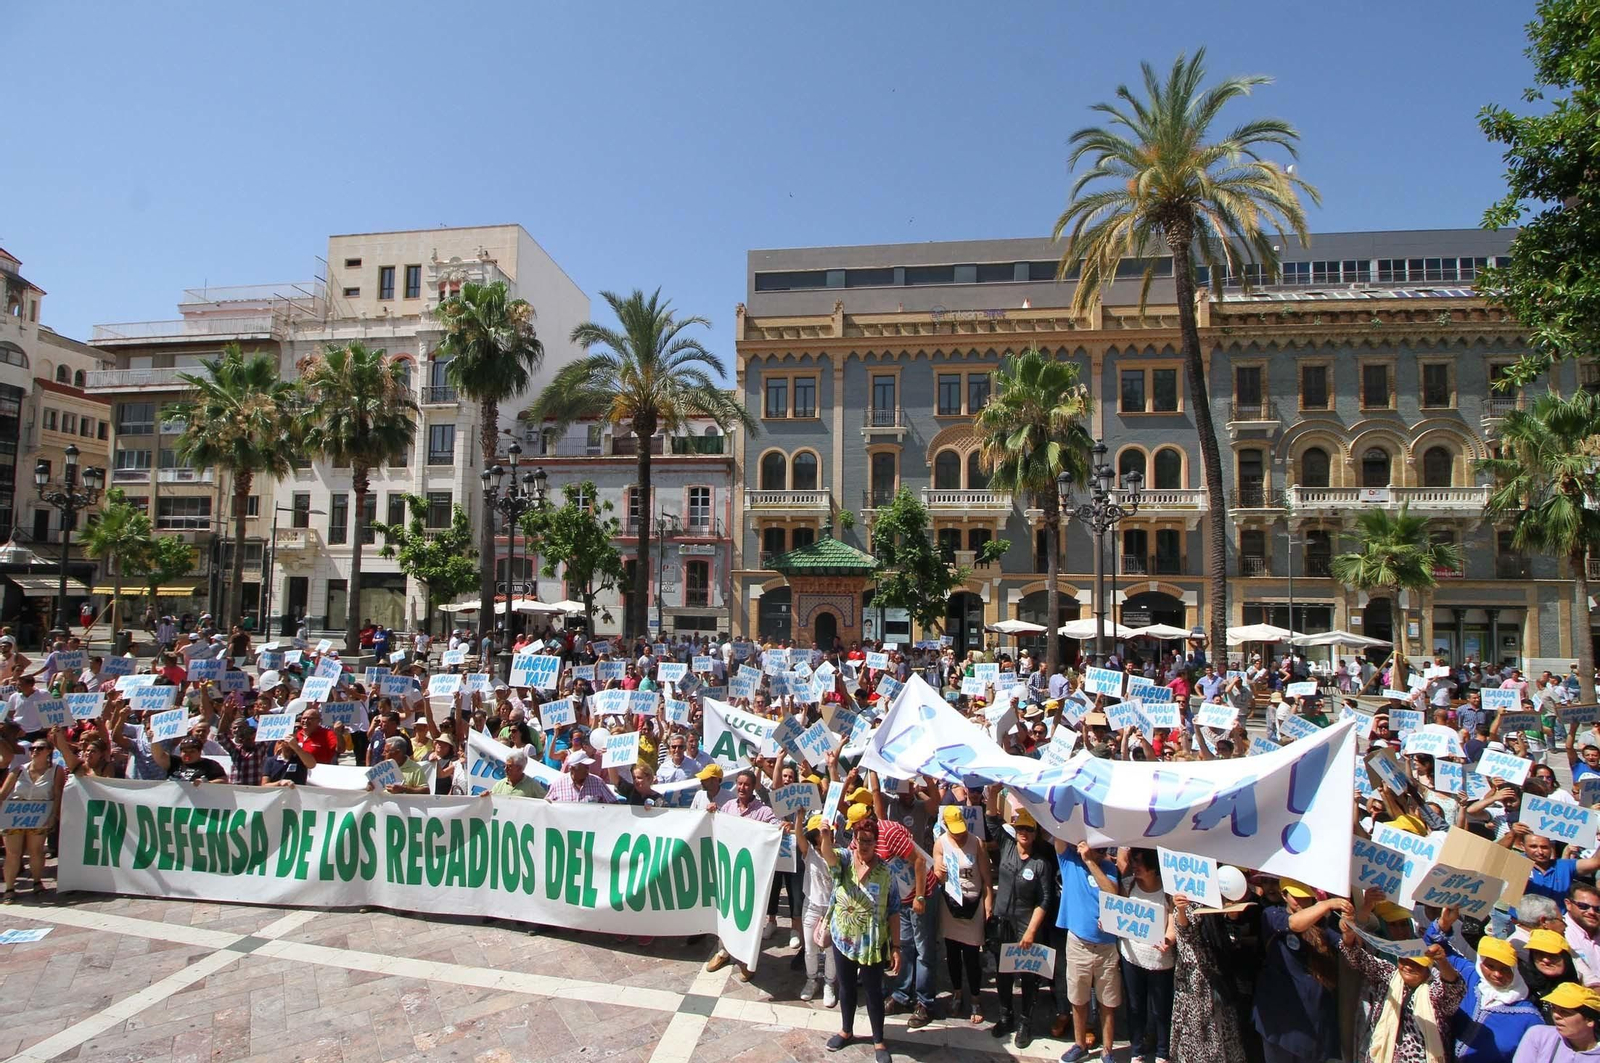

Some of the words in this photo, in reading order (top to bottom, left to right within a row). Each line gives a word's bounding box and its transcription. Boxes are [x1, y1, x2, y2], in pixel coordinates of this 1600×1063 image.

[514, 656, 557, 672] ¡¡AGUA
[524, 672, 549, 687] YA!!
[1089, 669, 1120, 683] ¡¡AGUA
[136, 688, 170, 697] ¡¡AGUA
[1096, 681, 1114, 694] YA!!
[1131, 687, 1171, 700] ¡¡AGUA
[66, 695, 98, 703] ¡¡AGUA
[1485, 690, 1515, 699] ¡¡AGUA
[140, 698, 165, 708] YA!!
[543, 702, 570, 715] ¡¡AGUA
[1147, 705, 1175, 713] ¡¡AGUA
[1491, 699, 1512, 708] YA!!
[72, 705, 94, 715] YA!!
[1109, 704, 1130, 716] ¡¡AGU
[1203, 704, 1233, 718] ¡¡AGUA
[153, 711, 182, 726] ¡¡AGUA
[261, 716, 290, 726] ¡¡AGUA
[549, 712, 567, 723] YA!!
[1118, 714, 1132, 725] YA
[1154, 715, 1172, 723] YA!!
[1206, 713, 1224, 726] YA!!
[159, 724, 179, 735] YA!!
[266, 729, 286, 738] YA!!
[607, 737, 634, 746] ¡¡AGUA
[801, 725, 825, 748] ¡¡AGUA
[812, 738, 830, 756] YA!!
[612, 749, 630, 761] YA!!
[1484, 753, 1524, 770] ¡¡AGUA
[369, 760, 394, 778] ¡¡AGUA
[1441, 764, 1462, 776] ¡¡AG
[1489, 766, 1514, 779] YA!!
[775, 785, 812, 802] ¡¡AGUA
[4, 804, 47, 814] ¡¡AGUA
[786, 797, 810, 809] YA!!
[1527, 798, 1589, 823] ¡¡AGUA
[11, 816, 39, 827] YA!!
[1539, 817, 1579, 838] YA!!
[1379, 828, 1434, 860] ¡¡AGUA
[1163, 853, 1209, 877] ¡¡AGUA
[1353, 840, 1414, 878] ¡¡AGUA
[83, 800, 127, 868] EN
[133, 805, 268, 876] DEFENSA
[275, 808, 317, 880] DE
[319, 811, 377, 882] LOS
[386, 808, 535, 895] REGADÍOS
[545, 827, 598, 908] DEL
[609, 833, 755, 932] CONDADO
[1174, 875, 1205, 896] YA!!
[1359, 865, 1401, 894] YA!!
[1105, 898, 1155, 922] ¡¡AGUA
[1116, 917, 1149, 937] YA!!
[1006, 947, 1048, 960] ¡¡AGUA
[1014, 960, 1040, 972] YA!!
